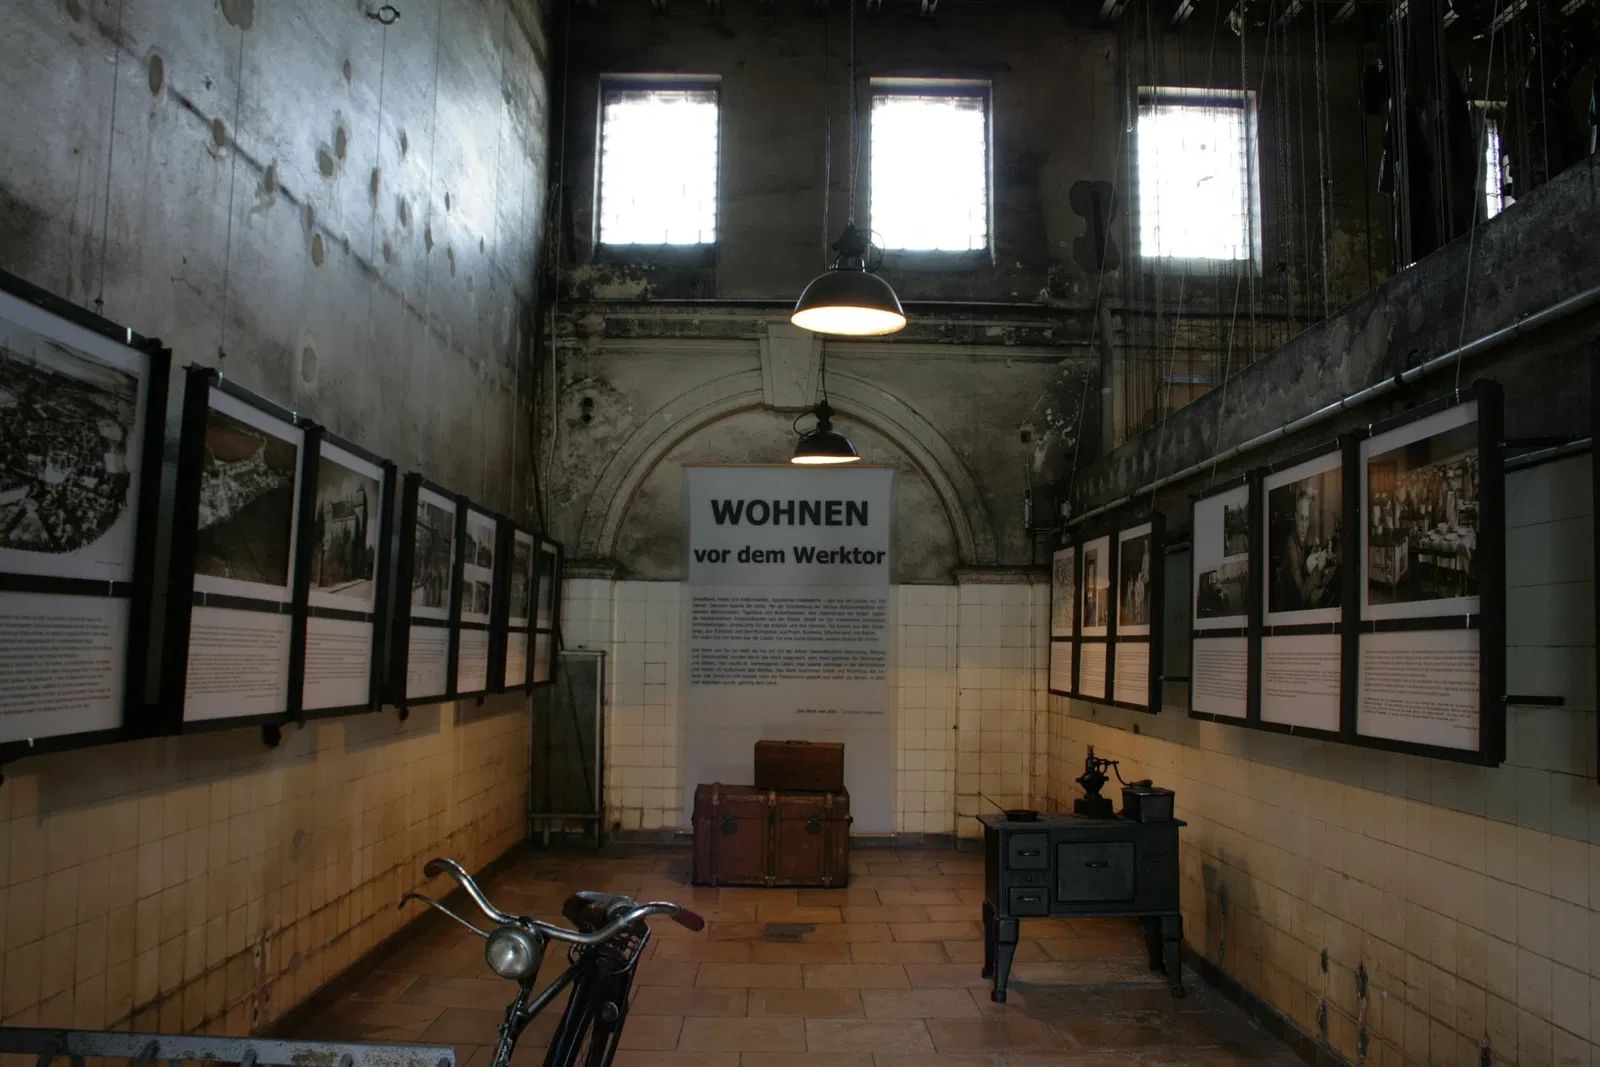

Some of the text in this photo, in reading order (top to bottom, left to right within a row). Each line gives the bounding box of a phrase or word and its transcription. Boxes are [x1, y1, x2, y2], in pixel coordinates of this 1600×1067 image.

[711, 499, 869, 526] WOHNEN
[694, 546, 886, 565] vor dem Werktor
